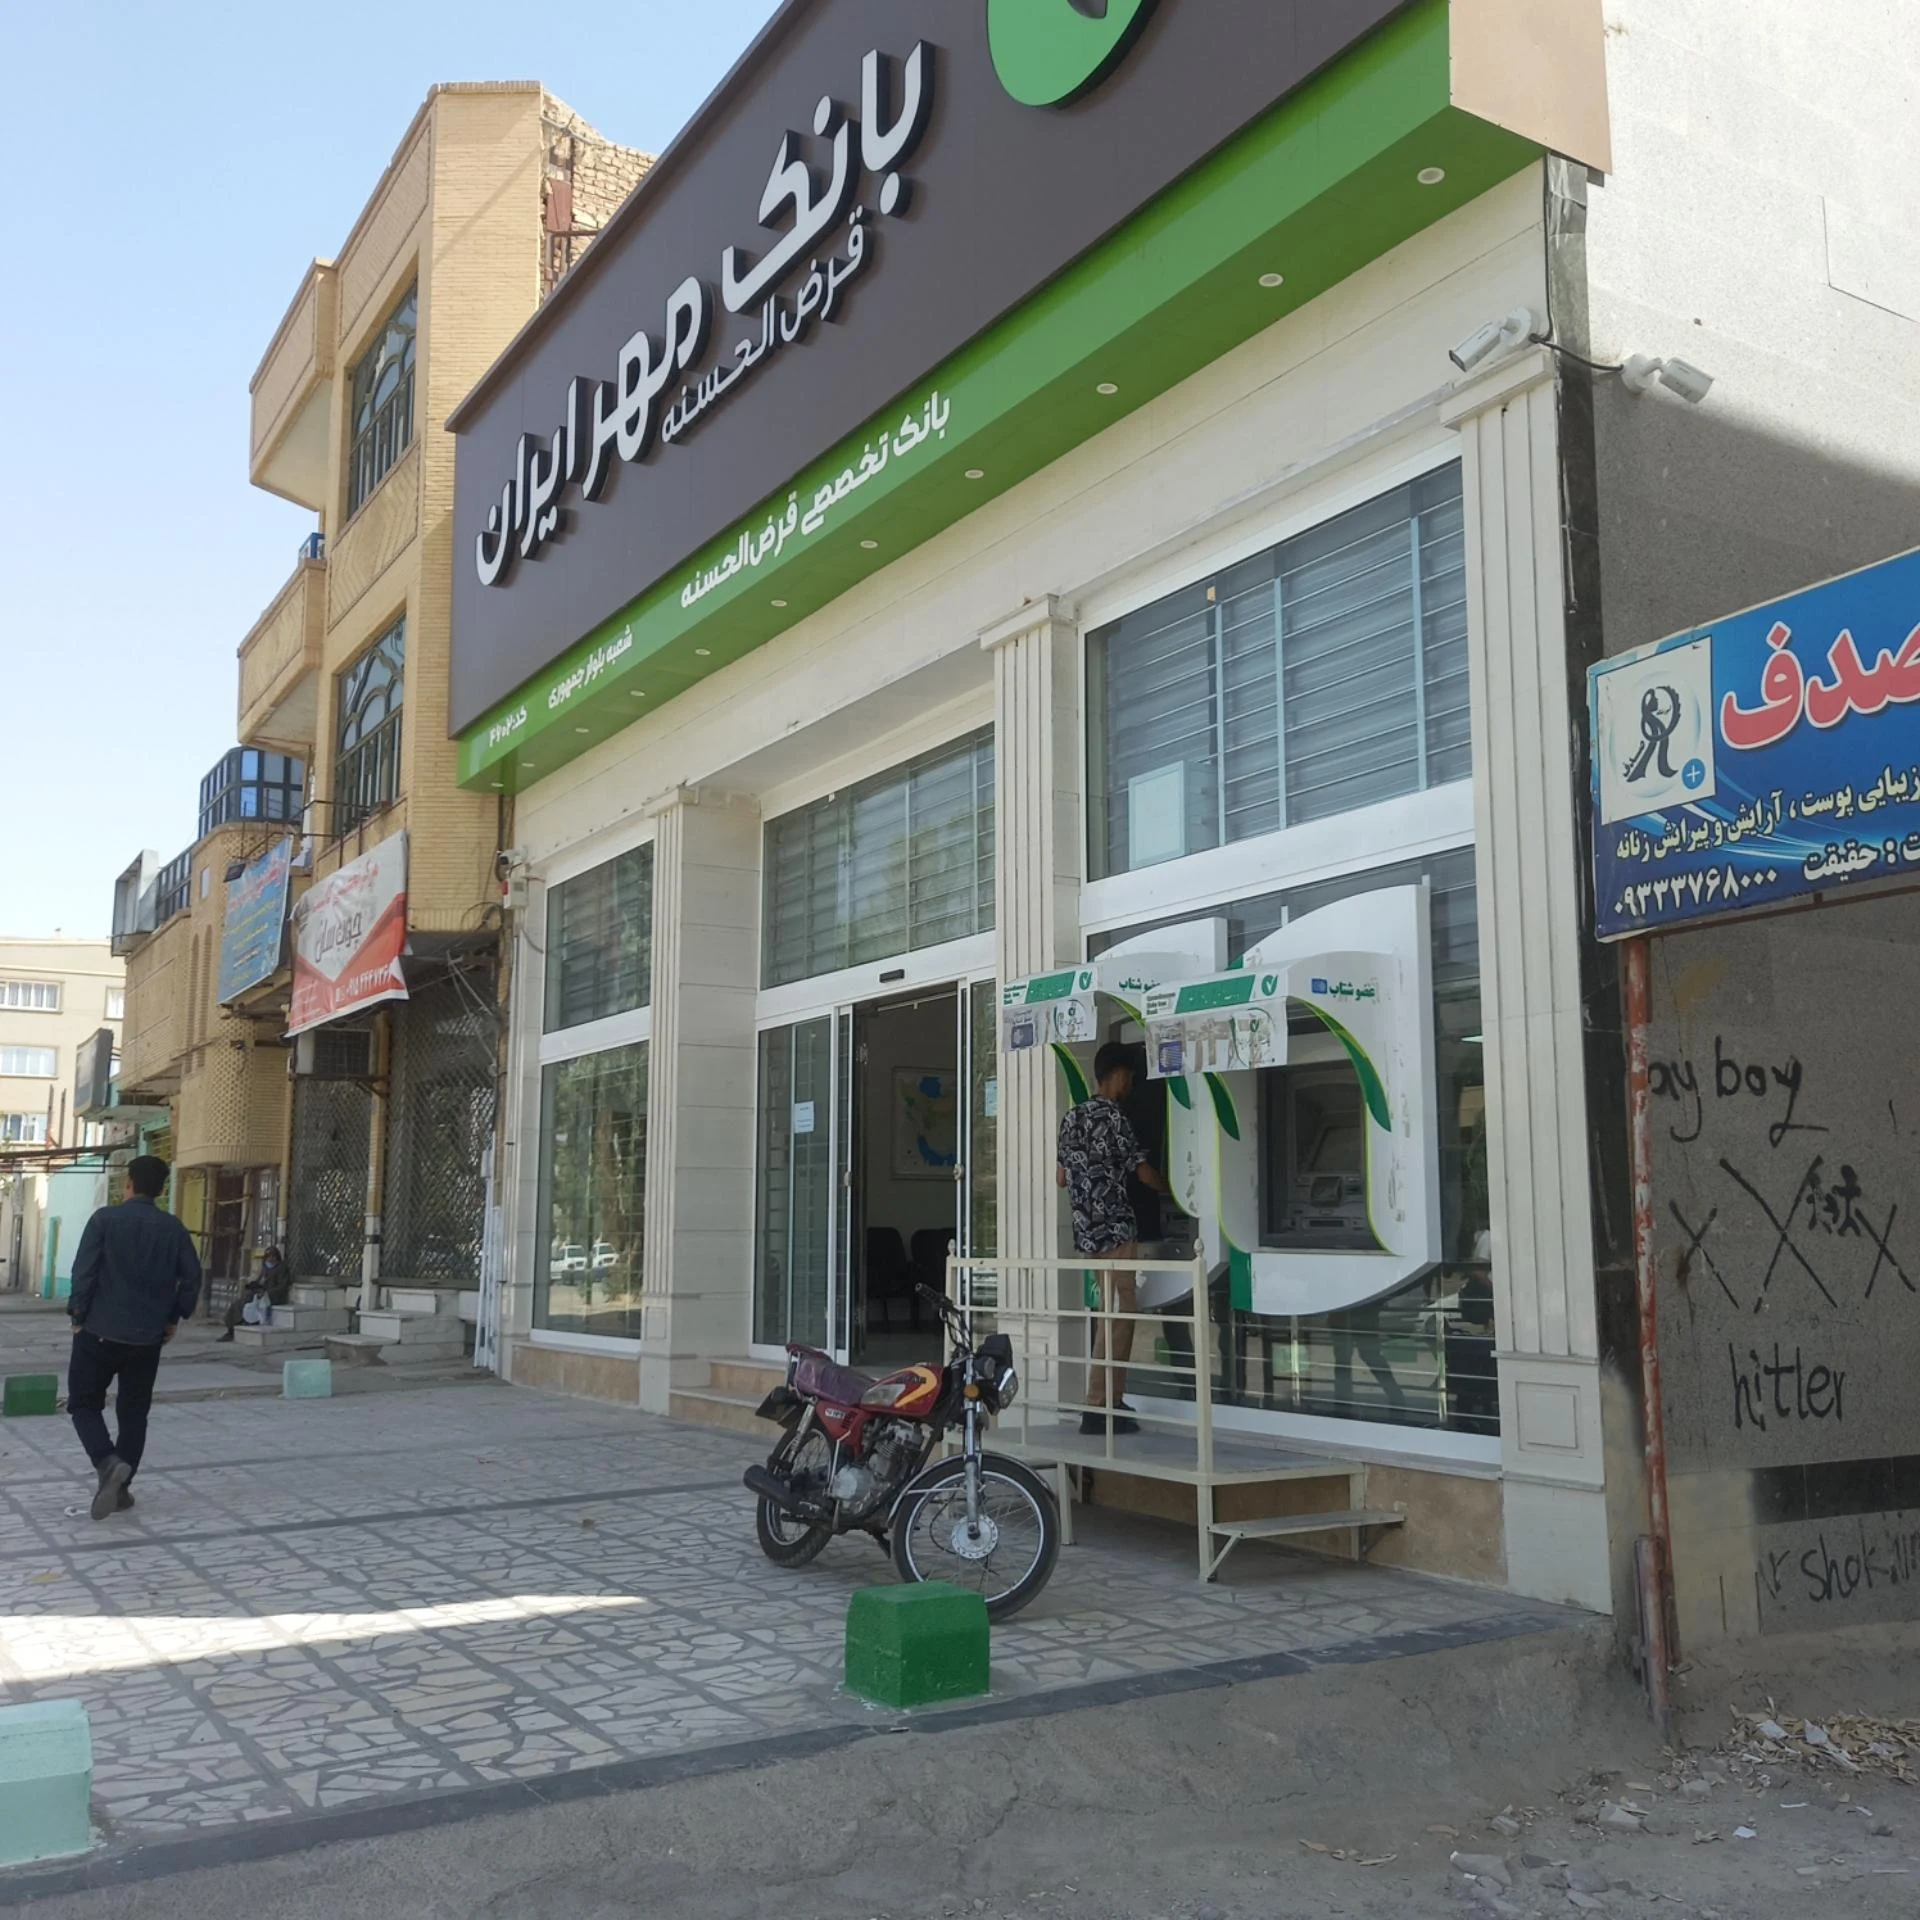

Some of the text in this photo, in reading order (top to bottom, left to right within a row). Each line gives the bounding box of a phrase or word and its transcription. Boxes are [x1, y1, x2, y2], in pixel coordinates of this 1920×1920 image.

[476, 40, 928, 586] بانک مهر ایران
[893, 391, 950, 456] بانک
[1654, 816, 1709, 859] پیرایش
[1713, 820, 1723, 847] و
[1727, 790, 1783, 842] آرایش
[1616, 830, 1650, 863] زنانه
[1803, 841, 1879, 882] حقیقت
[1715, 1035, 1829, 1148] boy
[1729, 1342, 1845, 1432] hitler
